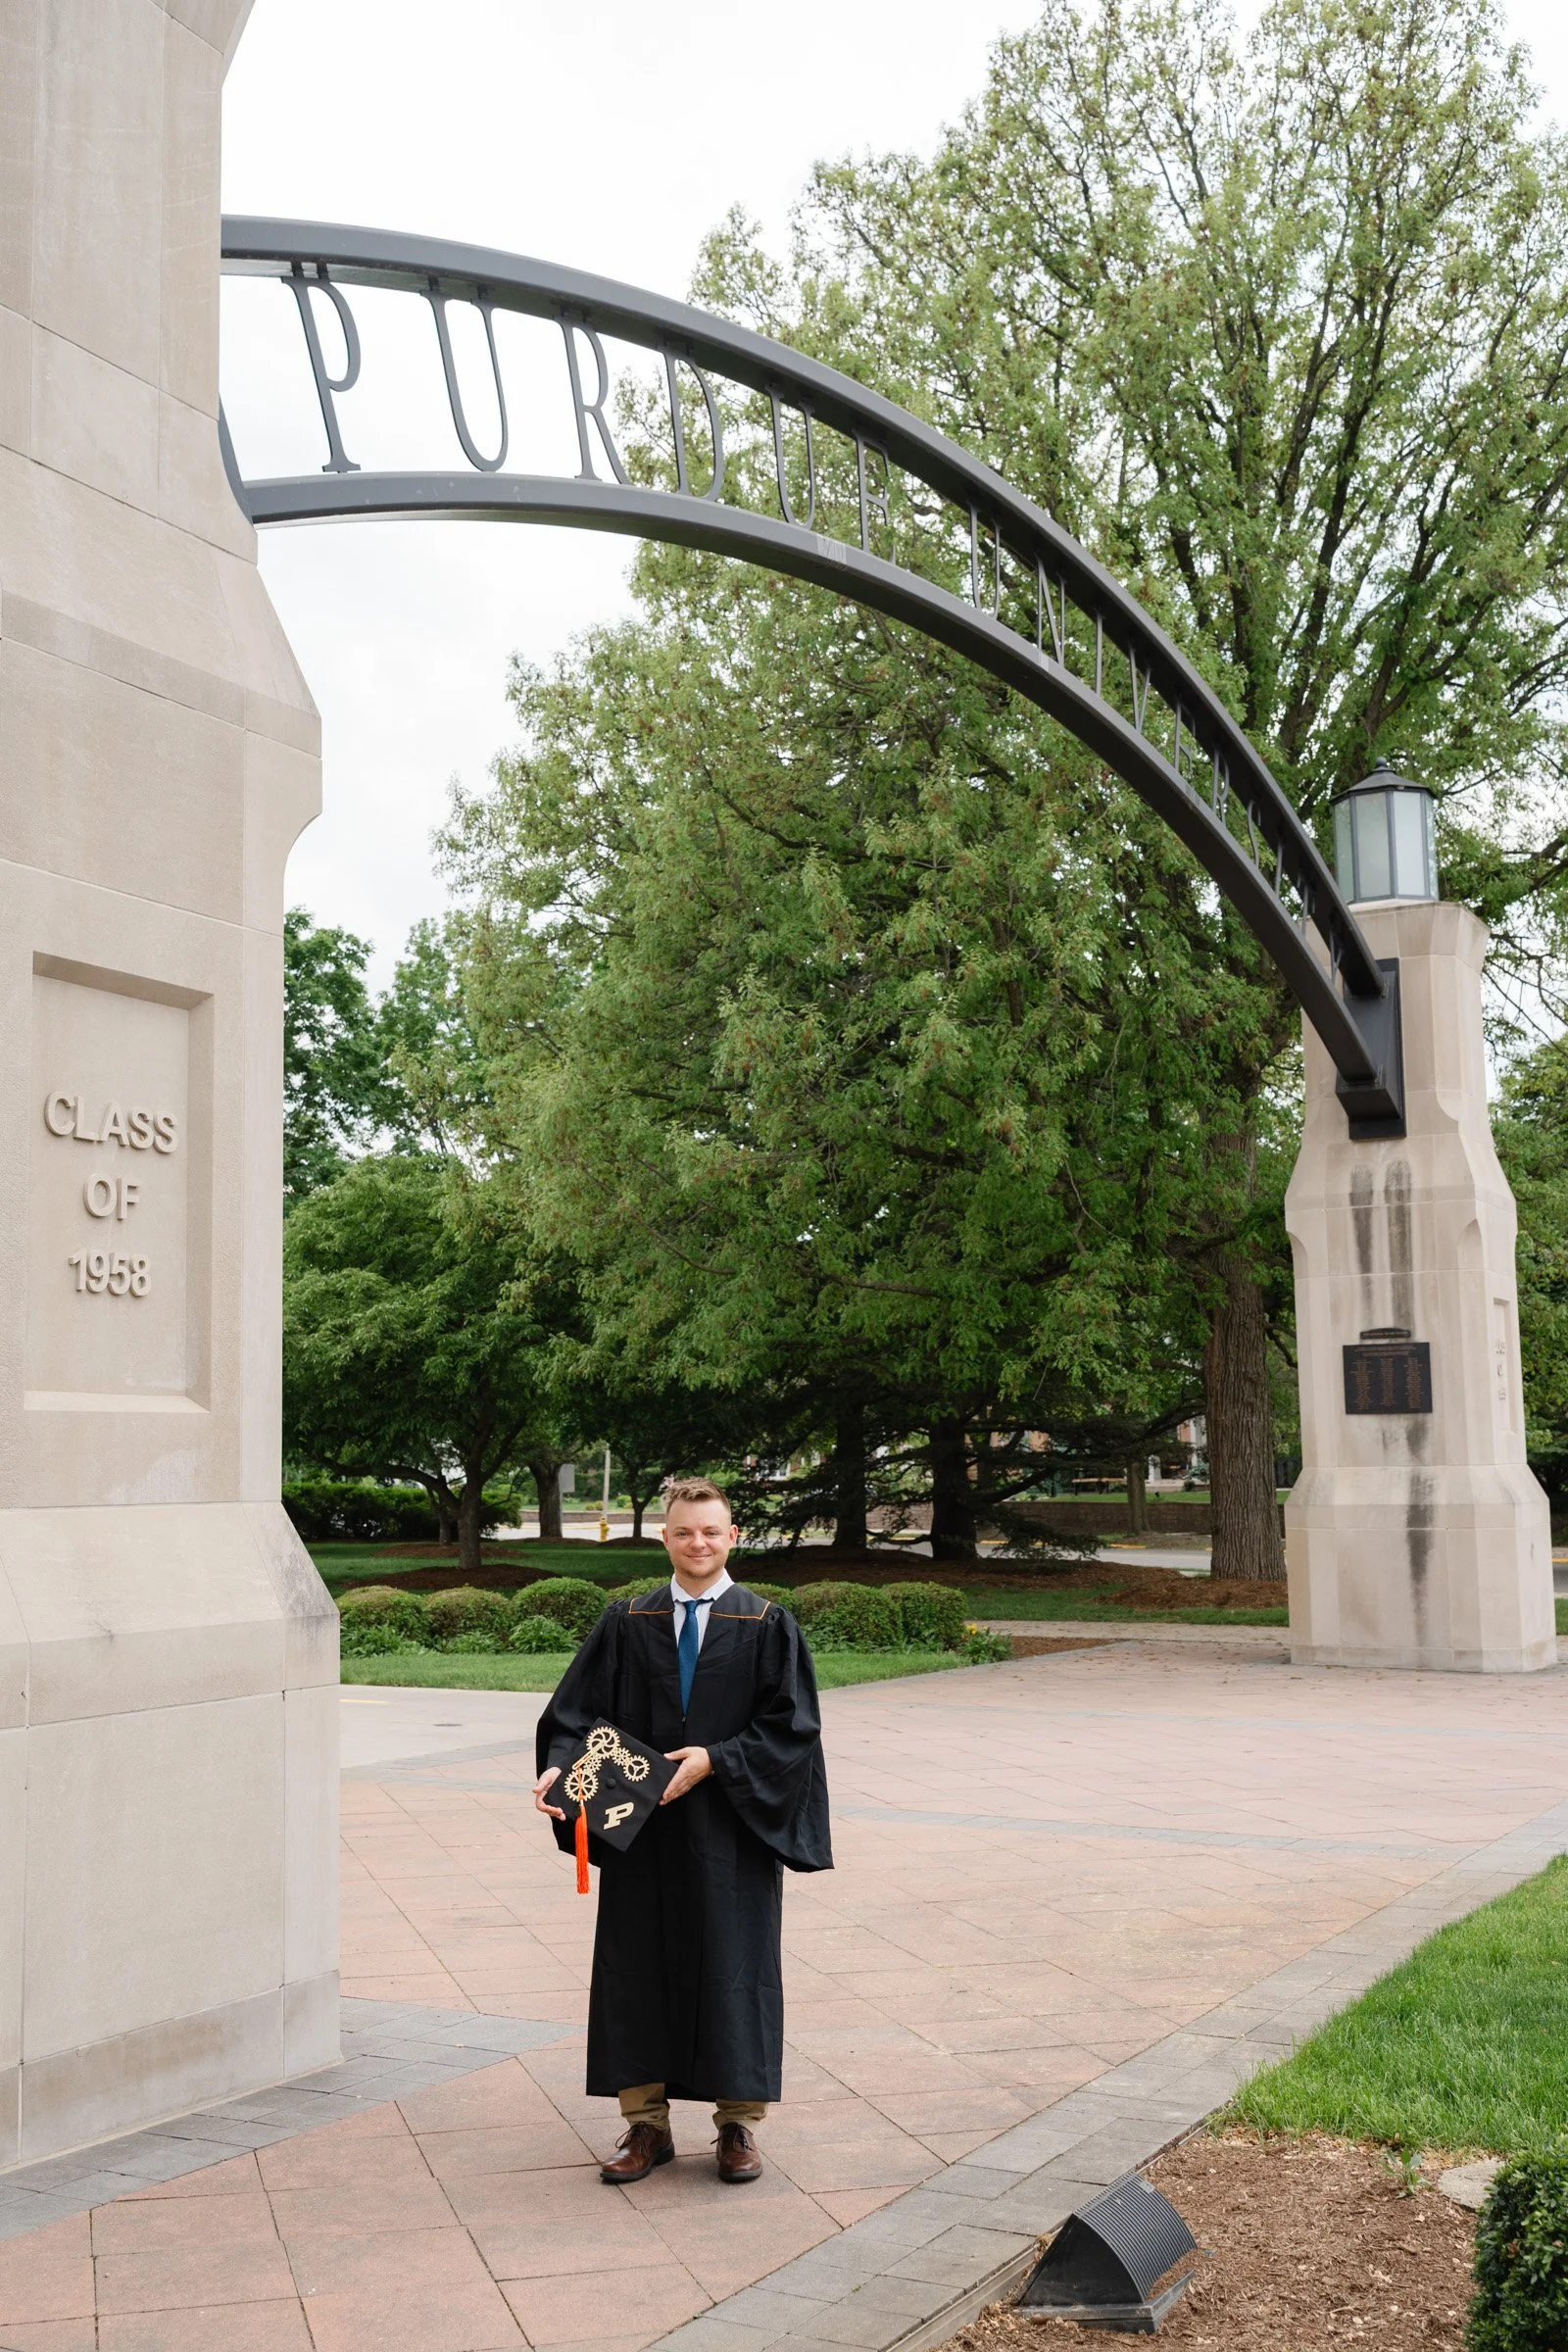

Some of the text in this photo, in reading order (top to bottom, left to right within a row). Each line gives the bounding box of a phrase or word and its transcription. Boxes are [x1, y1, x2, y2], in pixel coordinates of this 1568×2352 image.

[281, 274, 897, 565] PURDUE
[44, 1091, 179, 1154] CLASS
[83, 1172, 141, 1221] OF
[68, 1248, 152, 1298] 1958
[603, 1801, 635, 1831] P
